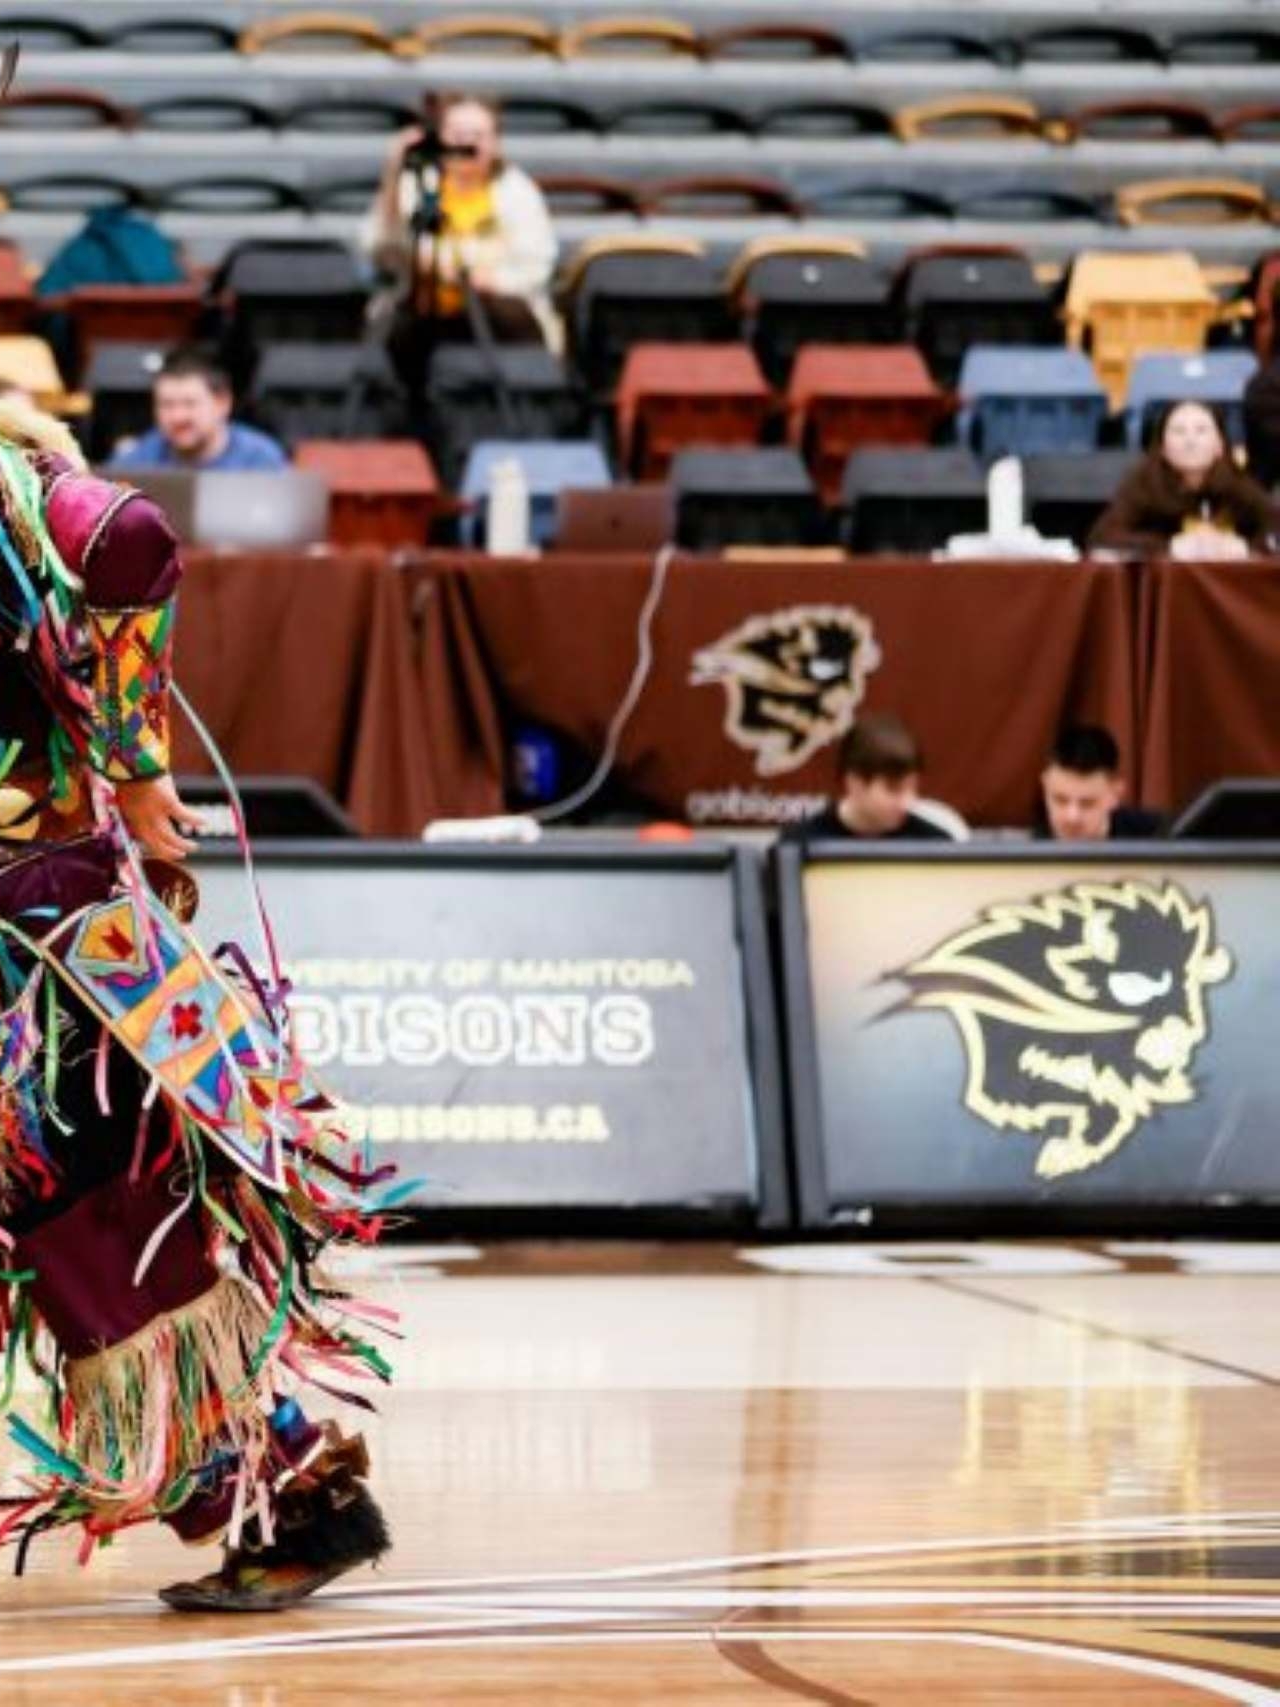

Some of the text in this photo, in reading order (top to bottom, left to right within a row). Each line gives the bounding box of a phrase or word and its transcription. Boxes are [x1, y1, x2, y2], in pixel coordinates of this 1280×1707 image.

[442, 959, 489, 986] OF
[499, 959, 694, 987] MANITOBA
[284, 994, 654, 1067] BISONS
